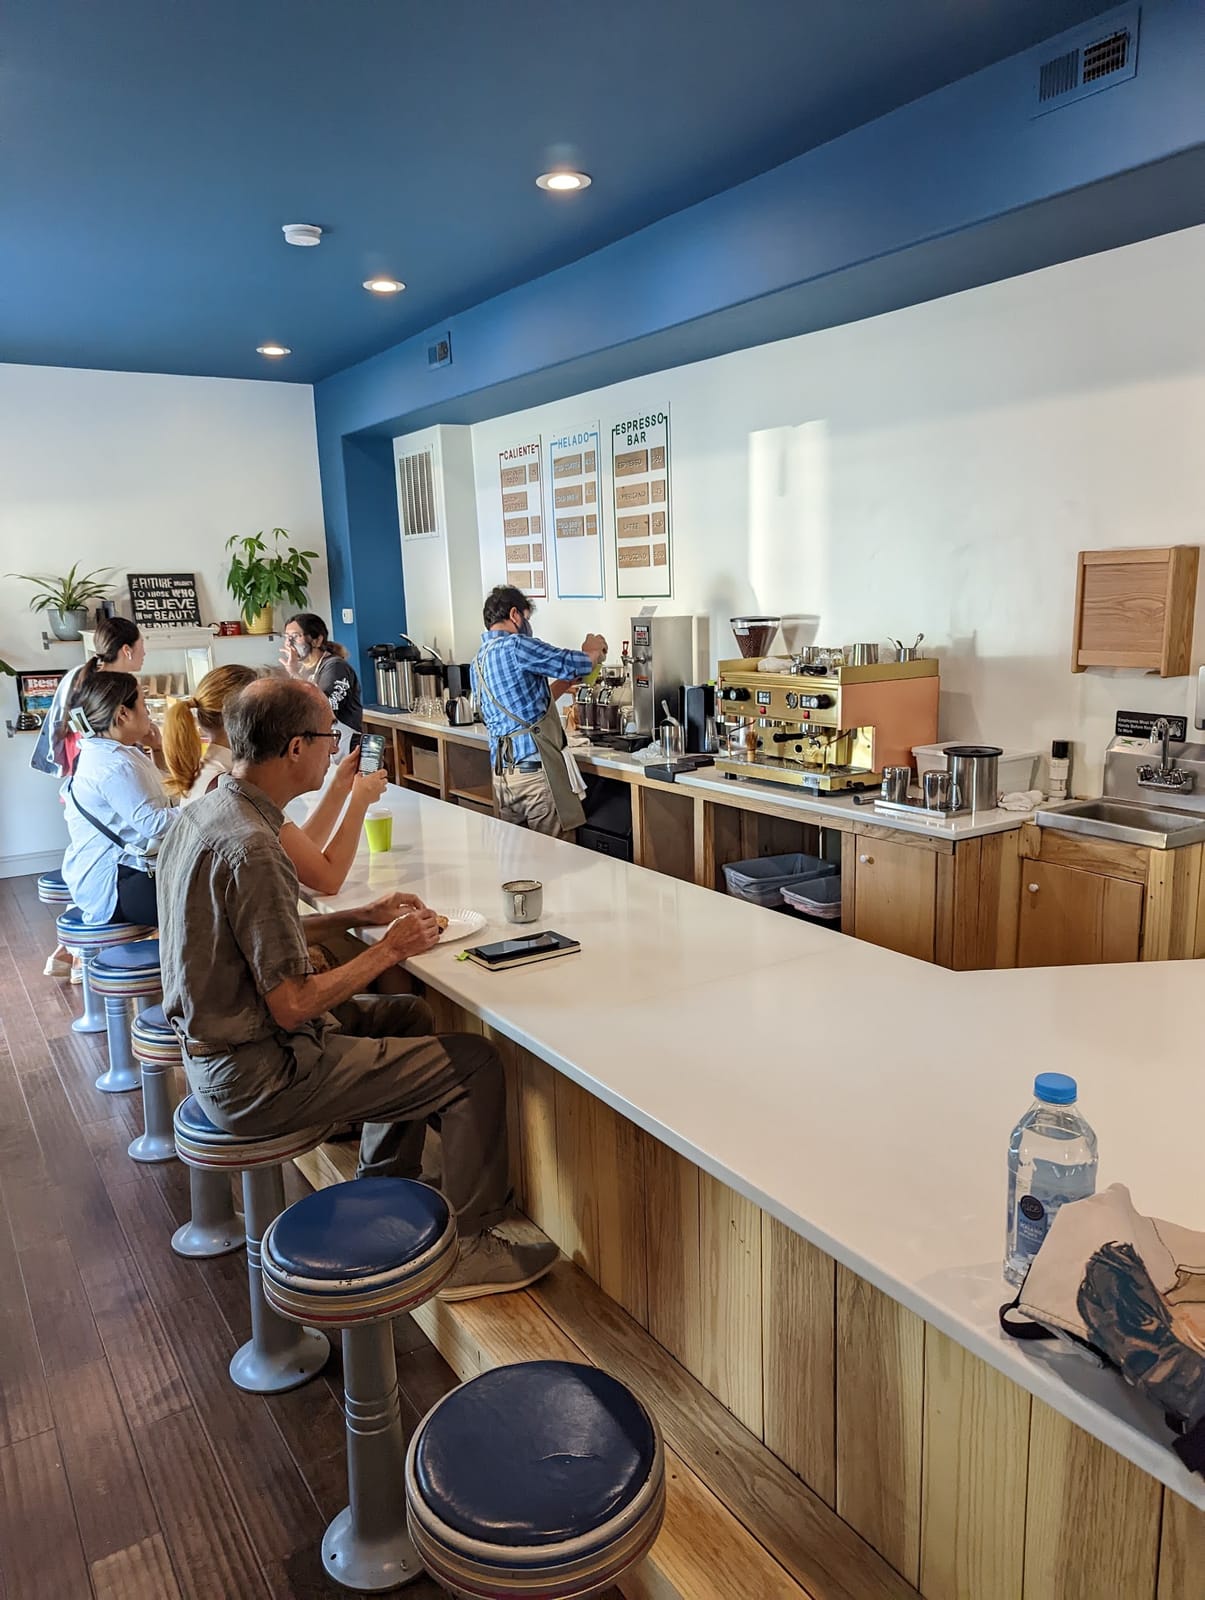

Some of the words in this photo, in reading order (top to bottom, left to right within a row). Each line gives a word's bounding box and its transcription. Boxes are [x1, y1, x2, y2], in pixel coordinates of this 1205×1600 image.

[615, 412, 664, 436] ESPRESSO
[557, 432, 589, 449] HELADO
[627, 431, 646, 446] BAR
[503, 443, 536, 460] CALIENTE
[139, 577, 172, 588] FUTURE
[132, 590, 146, 598] TO
[171, 588, 195, 598] WHO
[135, 599, 196, 610] BELIEVE
[135, 612, 143, 620] IN
[154, 610, 196, 621] BEAUTY
